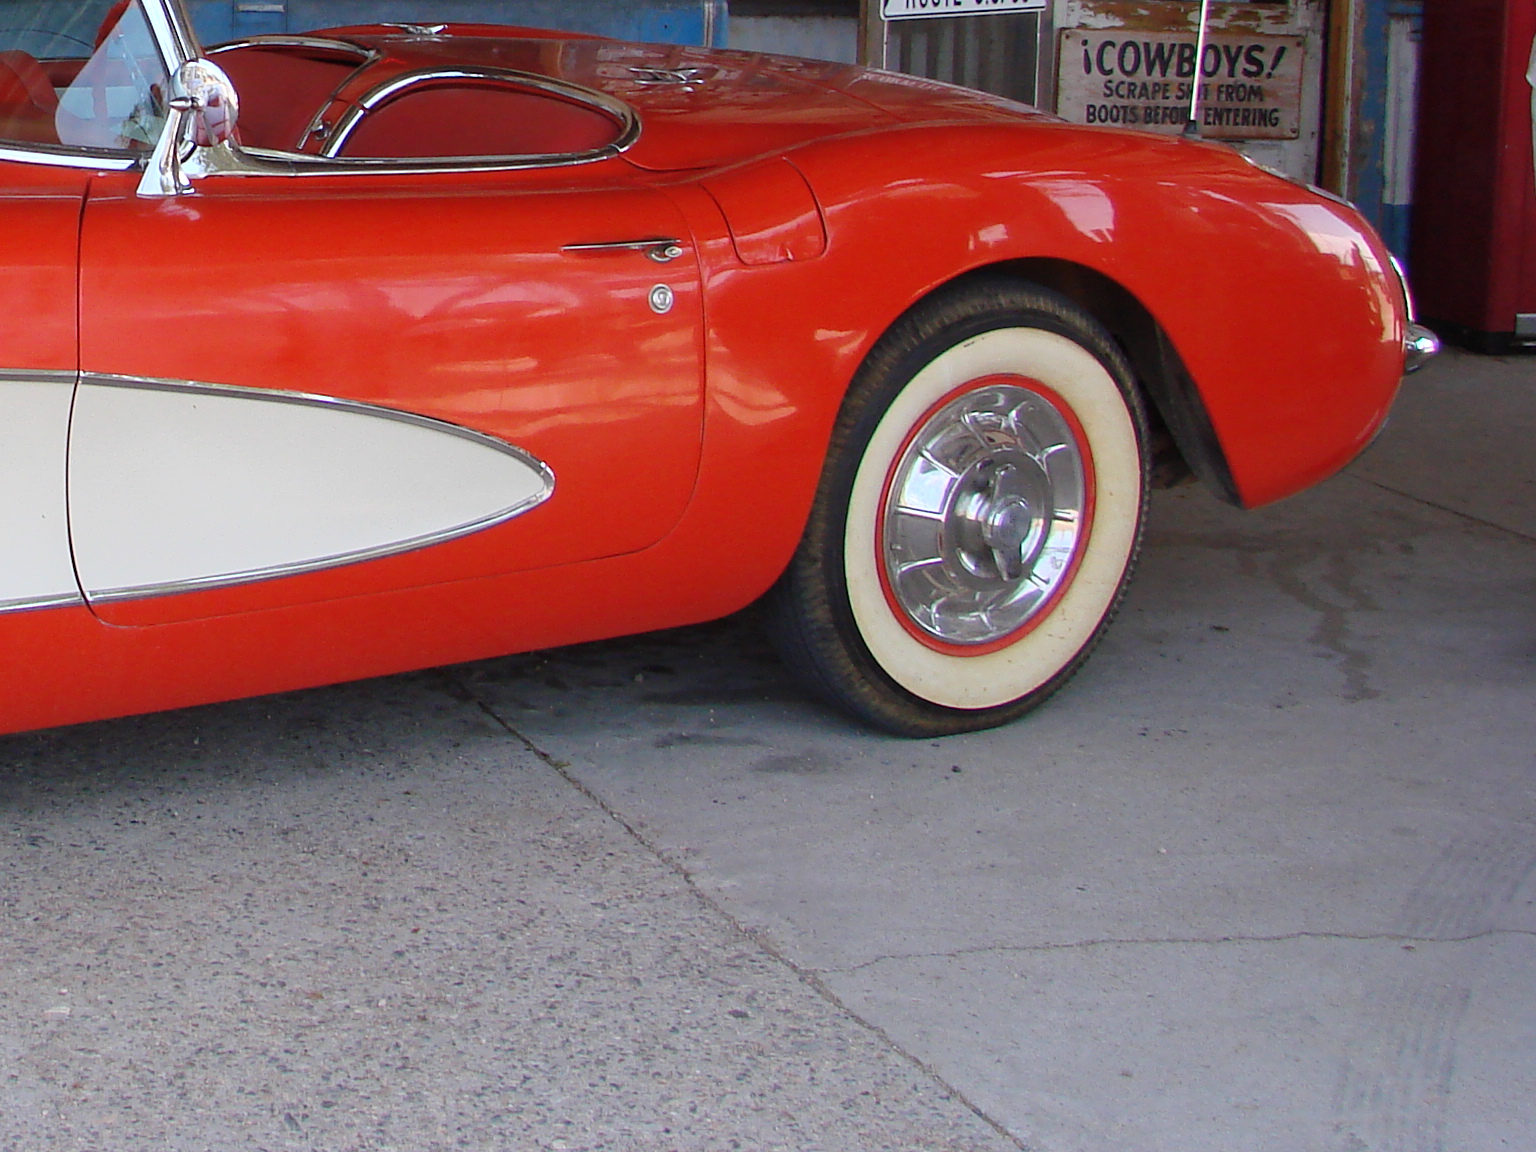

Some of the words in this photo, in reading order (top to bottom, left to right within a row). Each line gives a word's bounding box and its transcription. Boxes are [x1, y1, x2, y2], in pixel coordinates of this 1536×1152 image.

[1103, 79, 1170, 100] SCRAPE
[1175, 82, 1211, 102] SHT
[1216, 83, 1264, 103] FROM
[1086, 103, 1138, 125] BOOTS
[1143, 104, 1192, 126] BEFOR
[1203, 107, 1281, 128] ENTERING
